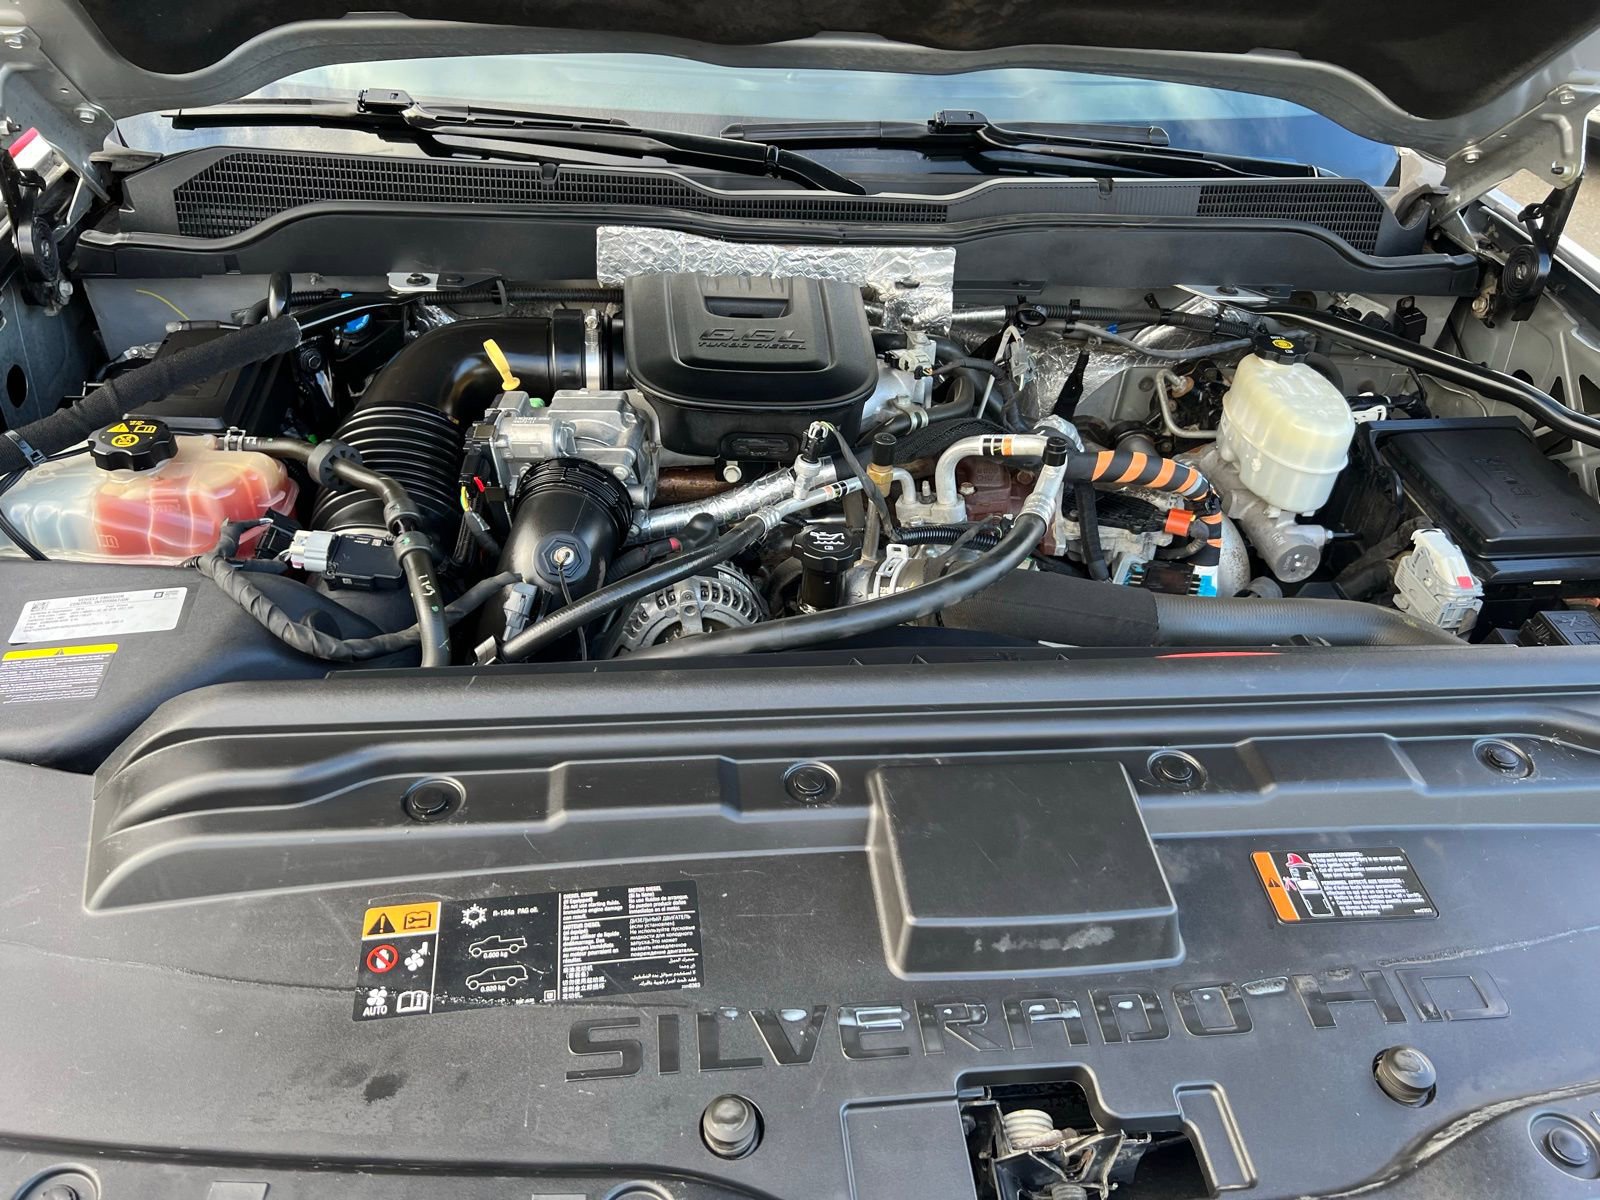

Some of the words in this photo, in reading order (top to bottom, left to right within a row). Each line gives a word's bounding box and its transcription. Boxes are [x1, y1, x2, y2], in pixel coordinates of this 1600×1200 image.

[699, 328, 805, 344] 6.6L
[363, 1005, 388, 1017] AUTO
[565, 982, 1254, 1082] SILVERADO
[1291, 967, 1511, 1029] HD
